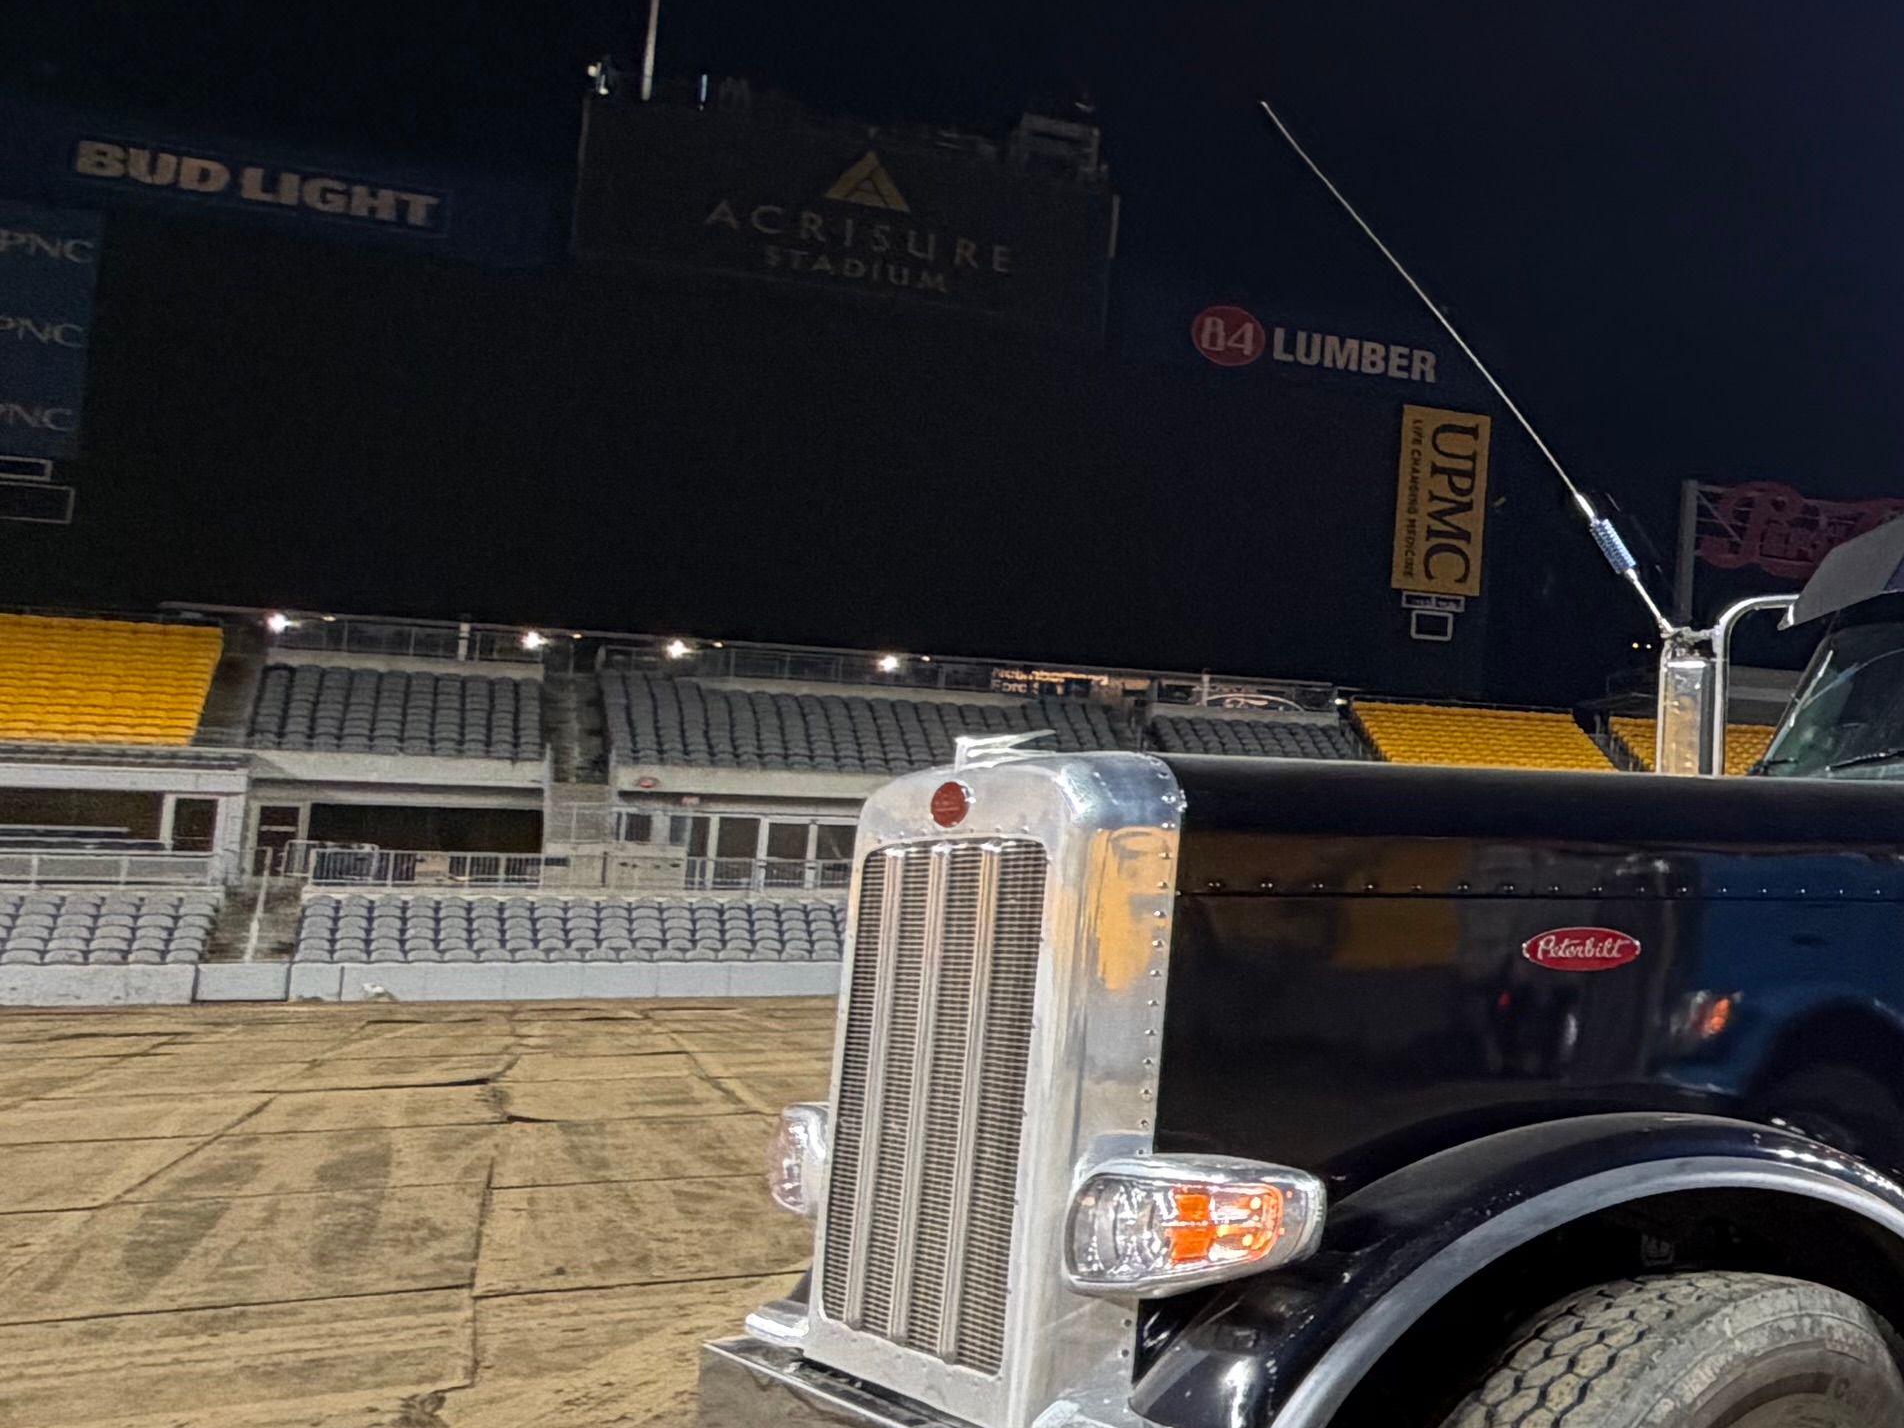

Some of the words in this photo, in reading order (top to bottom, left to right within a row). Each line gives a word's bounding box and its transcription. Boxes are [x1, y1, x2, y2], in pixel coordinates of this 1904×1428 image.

[75, 139, 231, 193] BUD
[239, 165, 441, 227] LIGHT
[703, 198, 1013, 274] ACRISURE
[765, 244, 948, 293] STADIUM
[1201, 316, 1254, 356] 84
[1273, 326, 1438, 383] LUMBER
[1407, 449, 1423, 518] CHANGING
[1423, 423, 1479, 584] UPMC
[1537, 935, 1630, 961] Peterbilt
